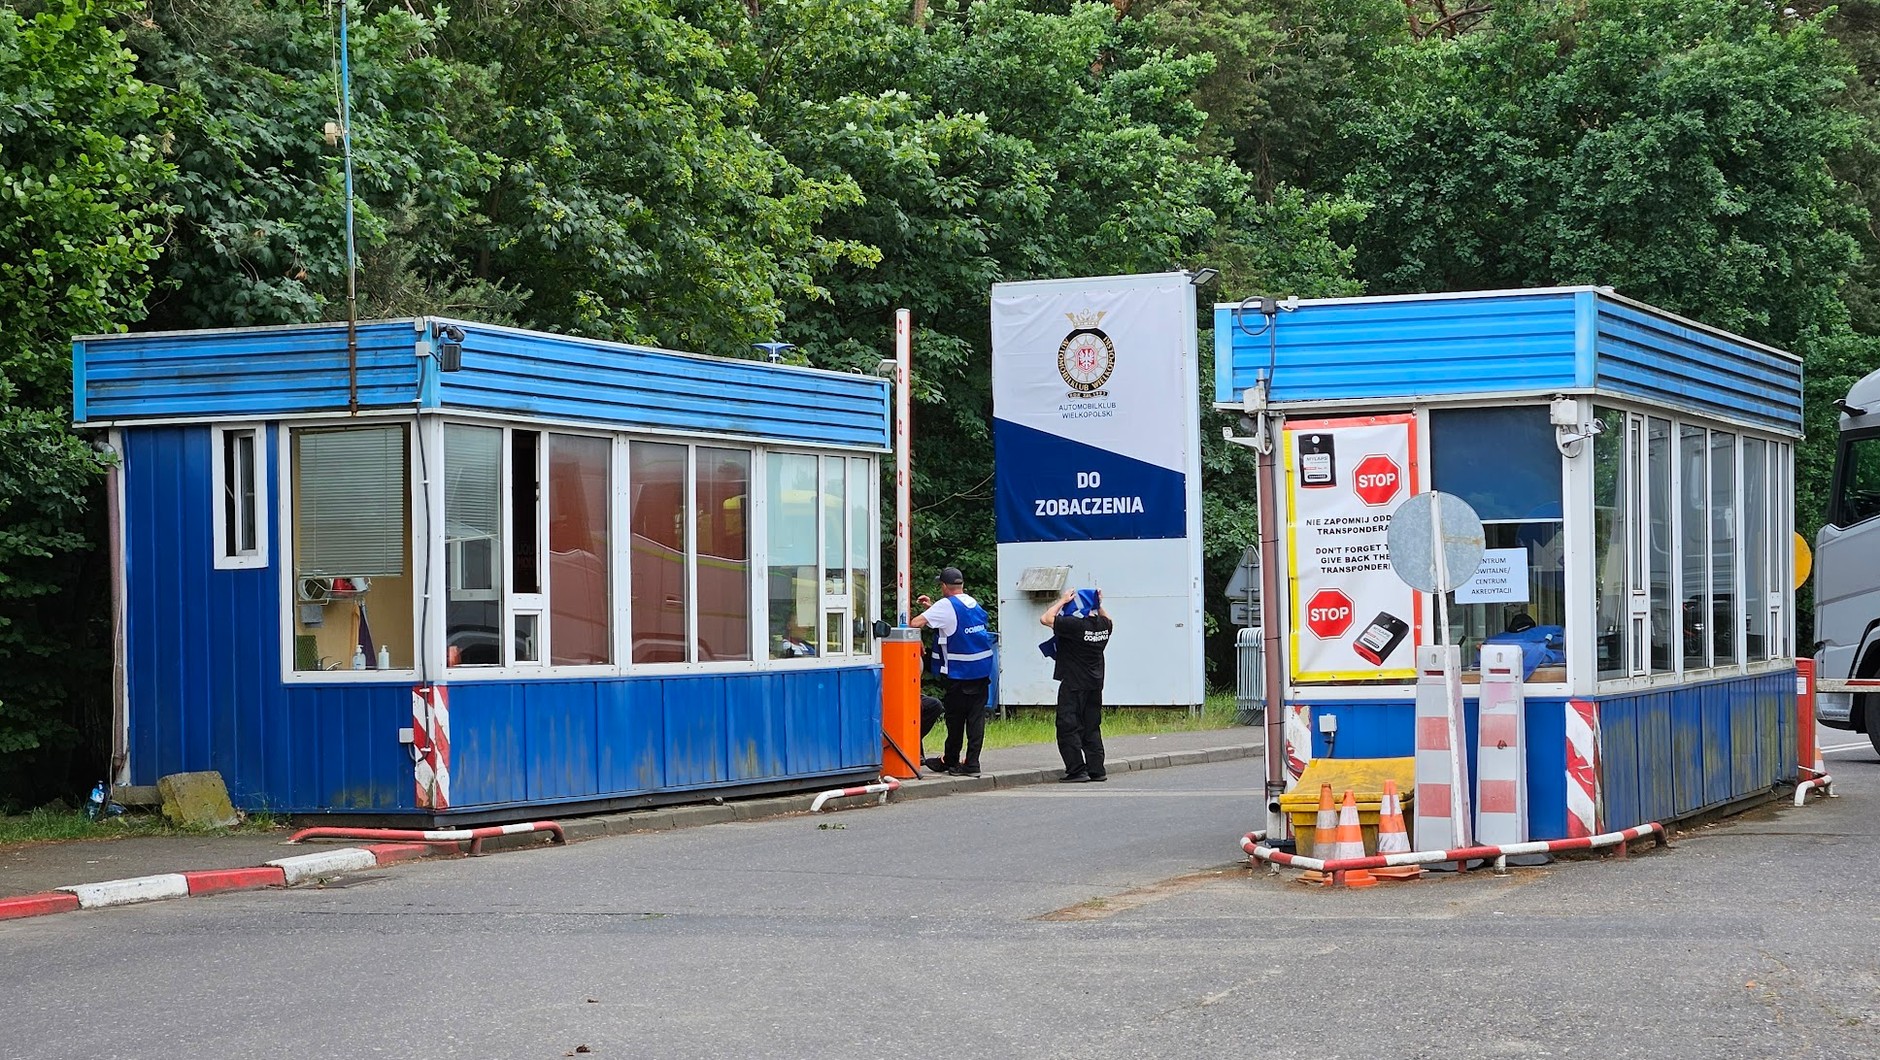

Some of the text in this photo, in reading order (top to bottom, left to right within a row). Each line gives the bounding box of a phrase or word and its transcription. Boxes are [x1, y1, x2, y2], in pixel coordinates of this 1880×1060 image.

[1059, 402, 1116, 411] AUTOMOBILKLUB
[1062, 410, 1113, 419] WIELKOPOLSKI
[1077, 471, 1101, 489] DO
[1358, 473, 1396, 488] STOP
[1035, 496, 1144, 516] ZOBACZENIA
[1306, 514, 1392, 526] NIE ZAPOMNIJ ODD
[1315, 543, 1389, 555] DON'T FORGET T
[1320, 556, 1342, 564] GIVE
[1345, 555, 1370, 563] BACK
[1310, 607, 1349, 622] STOP
